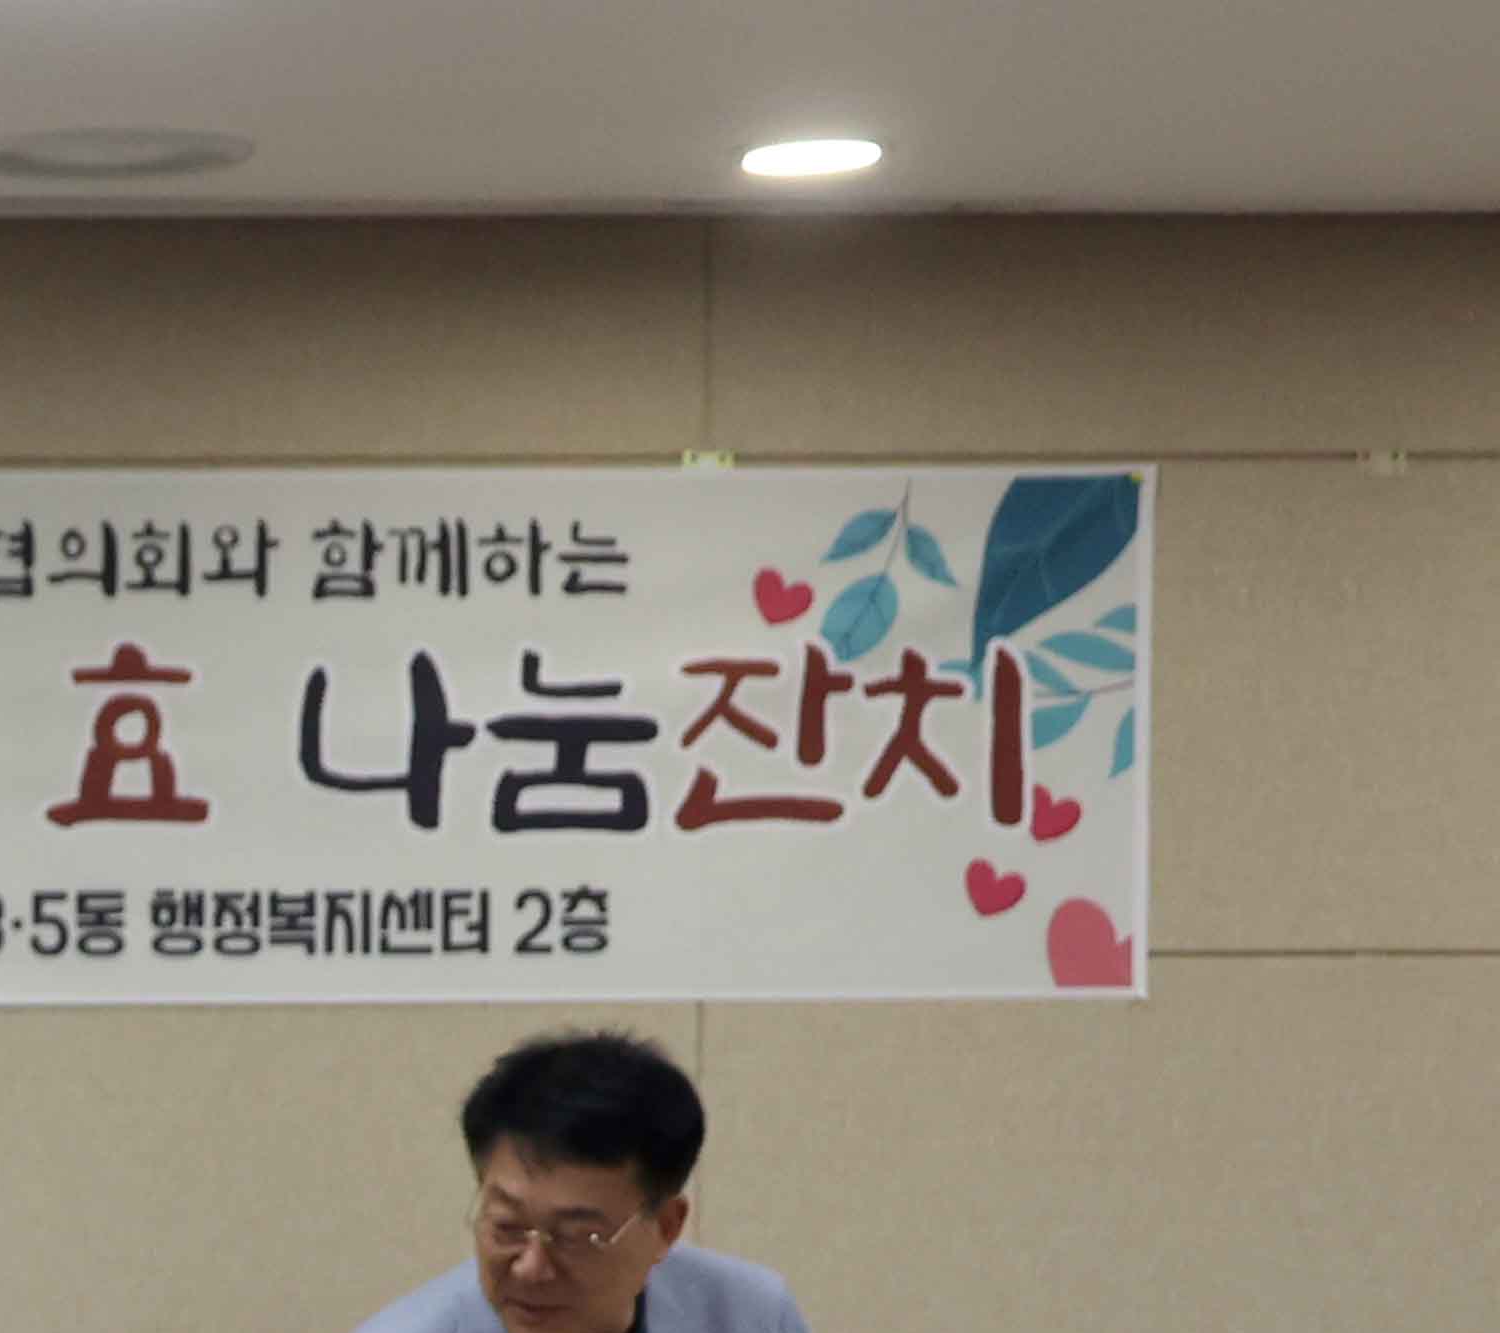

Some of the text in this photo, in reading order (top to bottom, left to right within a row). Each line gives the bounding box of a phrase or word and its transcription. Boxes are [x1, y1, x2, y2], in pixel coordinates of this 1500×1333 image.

[311, 519, 630, 600] 함께하는
[45, 642, 210, 829] 효
[297, 645, 1026, 836] 나눔잔치
[151, 890, 489, 956] 행정복지센터
[514, 887, 609, 954] 2층
